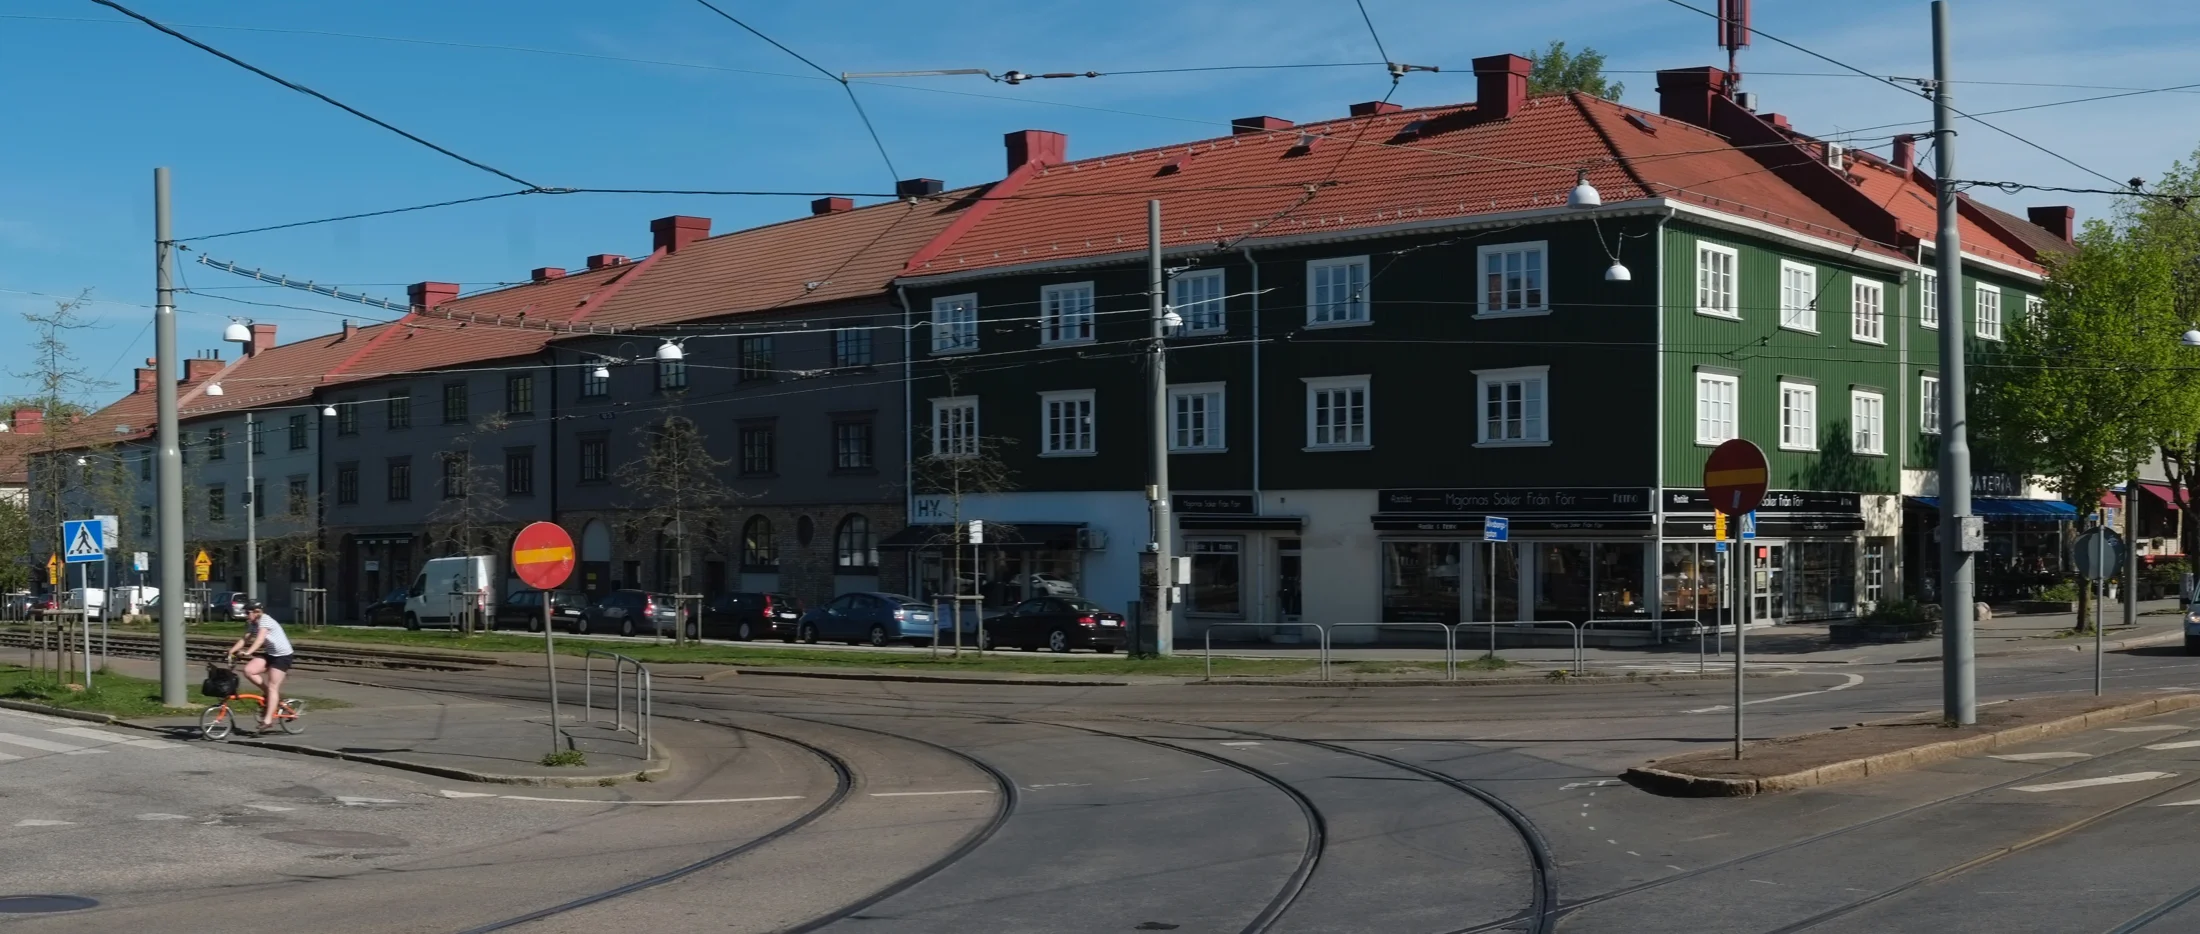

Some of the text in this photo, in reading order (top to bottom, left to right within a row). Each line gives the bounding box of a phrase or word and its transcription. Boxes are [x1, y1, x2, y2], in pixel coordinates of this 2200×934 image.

[1445, 493, 1489, 510] Majornas
[1493, 492, 1522, 505] Saker
[1526, 492, 1550, 505] Från
[1555, 492, 1576, 505] Förr
